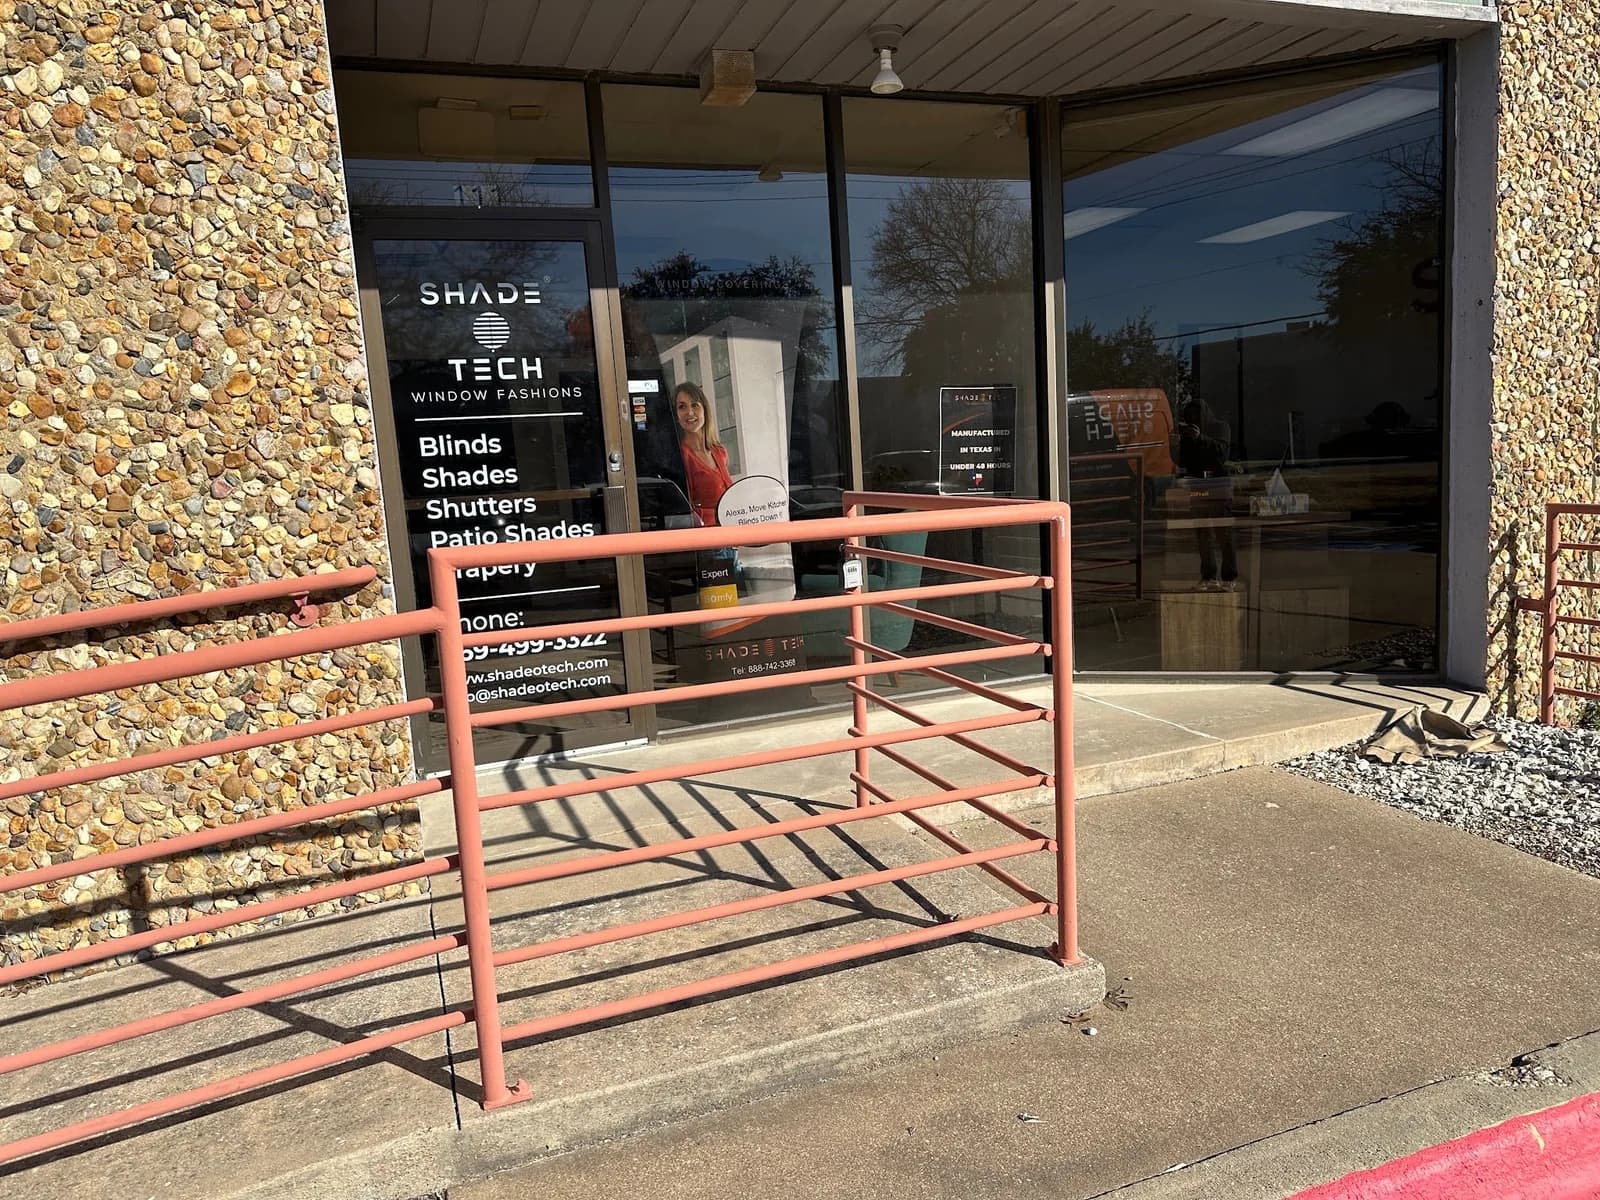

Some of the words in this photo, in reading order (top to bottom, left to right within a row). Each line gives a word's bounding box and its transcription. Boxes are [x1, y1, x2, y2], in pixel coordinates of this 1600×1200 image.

[419, 282, 541, 306] SHADE
[447, 357, 543, 382] TECH
[411, 389, 488, 403] WINDOW
[497, 386, 583, 400] FASHIONS
[951, 429, 1010, 437] MANUFACTURED
[419, 433, 503, 457] Blinds
[422, 465, 519, 489] Shades
[426, 496, 537, 519] Shutters
[724, 505, 748, 519] Alexa,
[748, 503, 767, 513] Move
[760, 512, 779, 523] Down
[430, 525, 498, 550] Patio
[504, 520, 595, 544] Shades
[456, 562, 537, 582] rapery
[701, 567, 729, 581] Expert
[459, 610, 525, 632] one:
[463, 632, 608, 662] 9-499-3322
[465, 656, 609, 685] w.shadeotech.com
[467, 673, 612, 703] o@shadeotech.com
